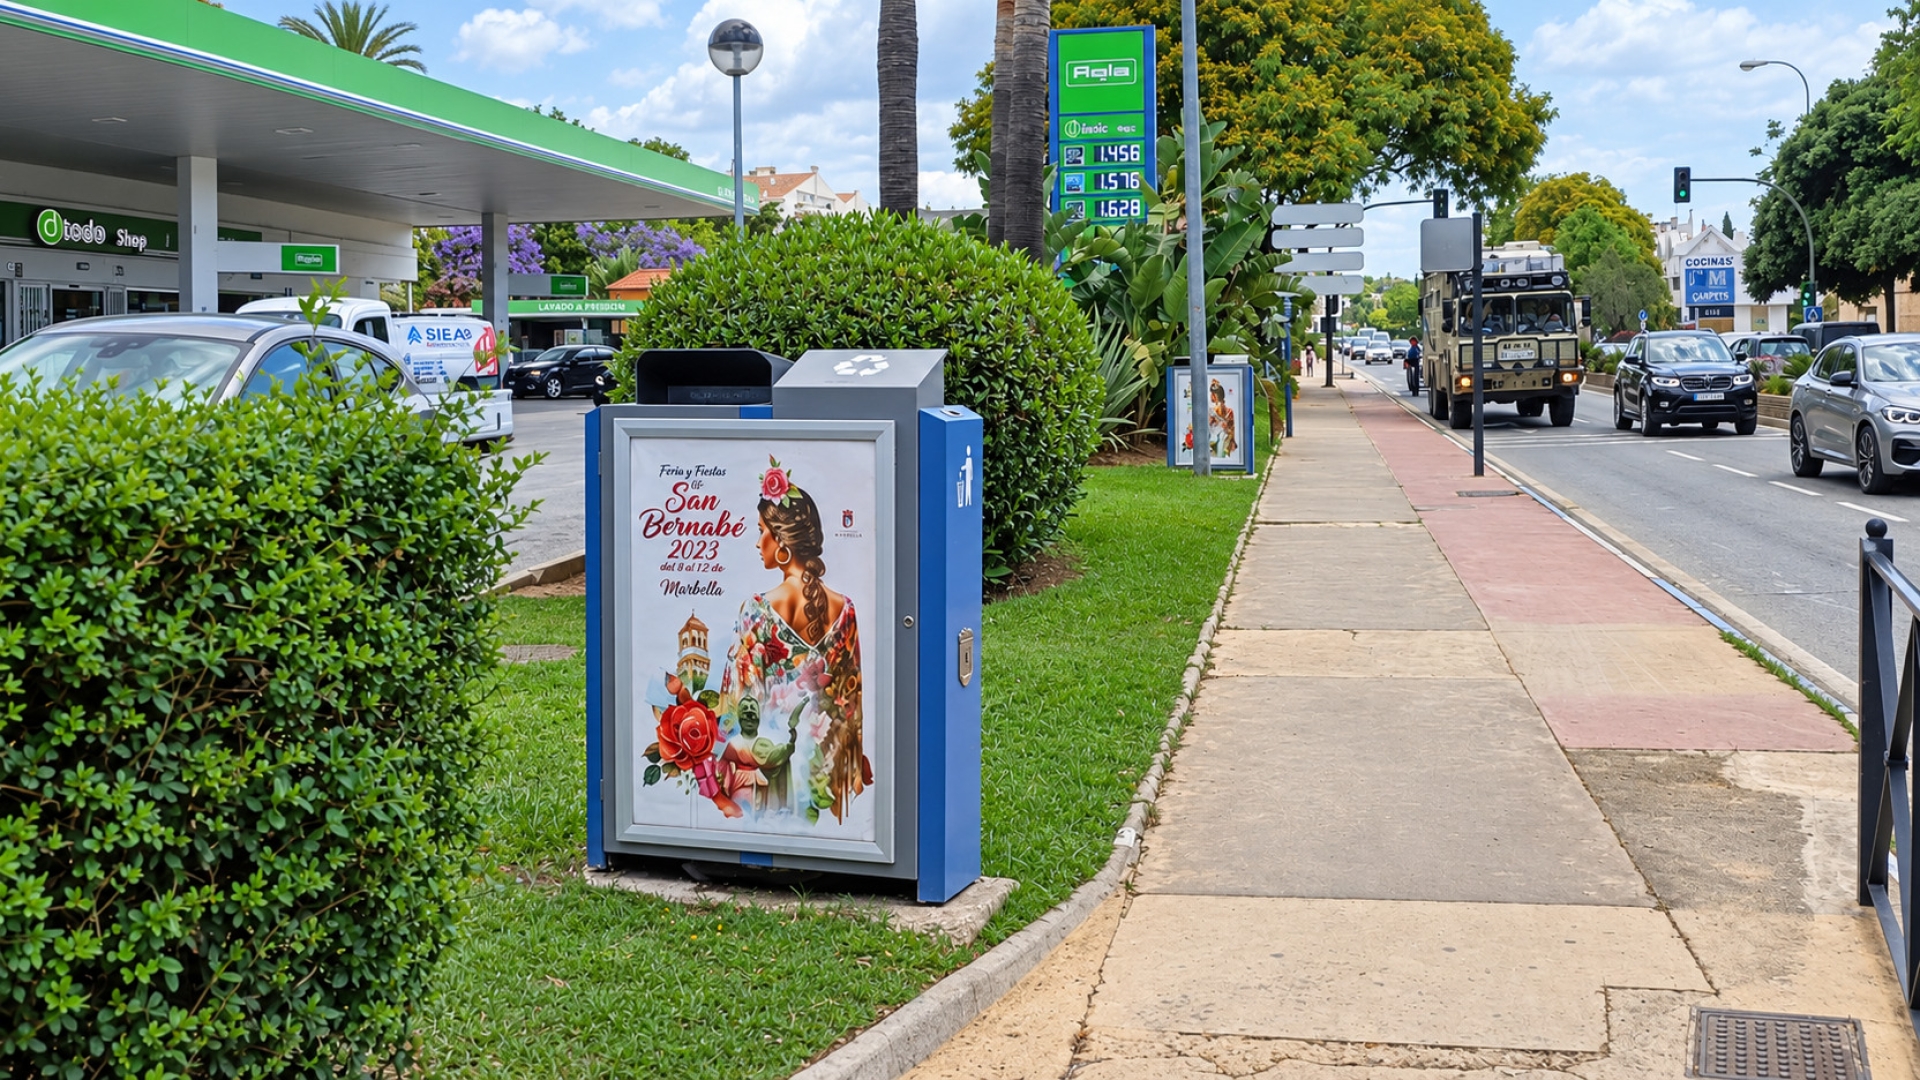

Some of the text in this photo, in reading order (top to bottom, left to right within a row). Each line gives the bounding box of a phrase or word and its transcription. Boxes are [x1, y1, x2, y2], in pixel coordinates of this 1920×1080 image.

[1101, 144, 1140, 162] 1.456
[1101, 172, 1140, 190] 1.576
[1101, 199, 1141, 217] 1.628
[116, 228, 147, 252] Shop
[659, 464, 684, 477] Feria
[685, 469, 693, 480] y
[665, 481, 721, 514] San
[639, 508, 747, 539] Bernabé
[667, 539, 720, 560] 2023
[659, 578, 725, 598] Marbella
